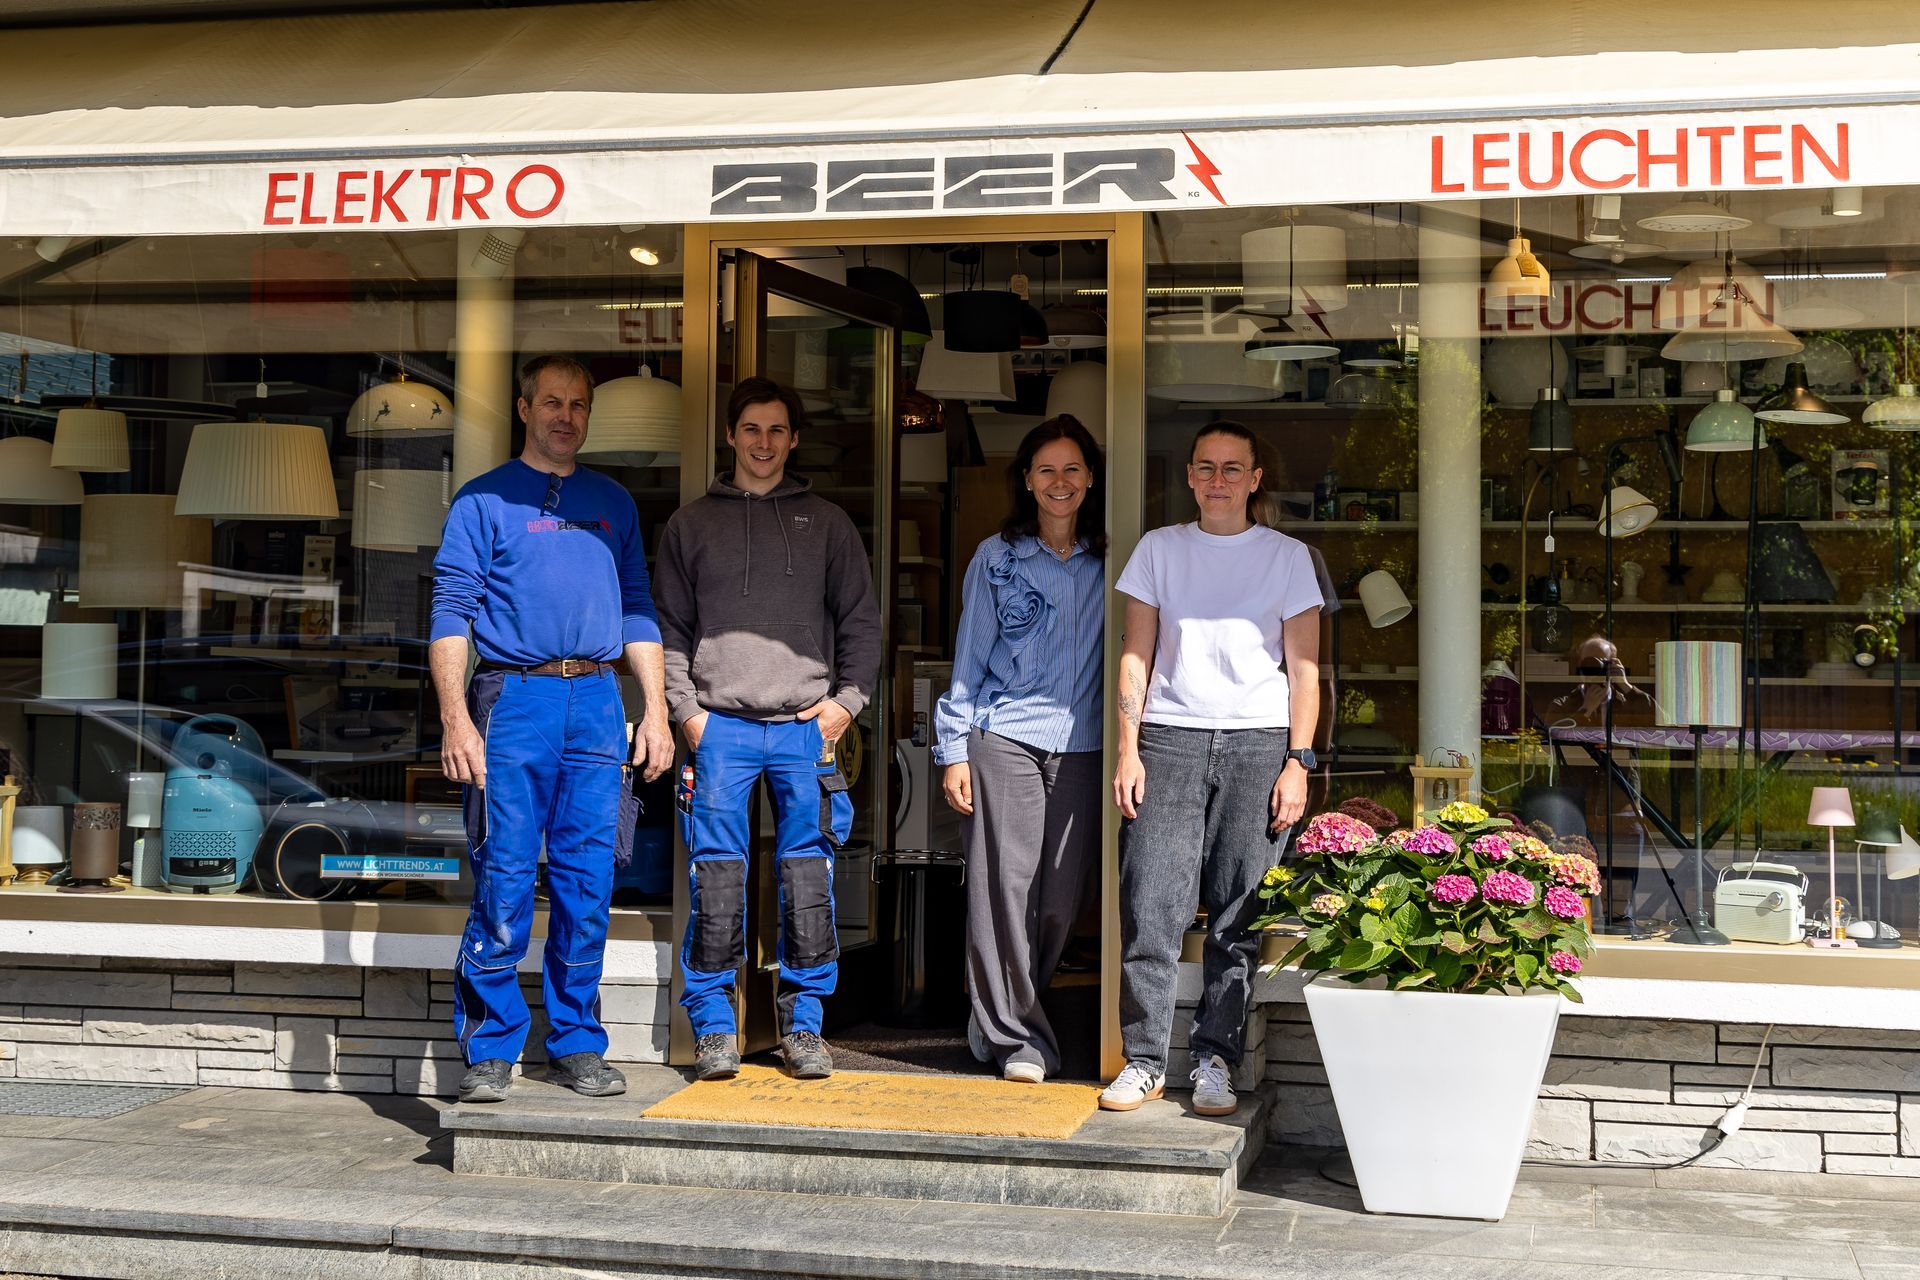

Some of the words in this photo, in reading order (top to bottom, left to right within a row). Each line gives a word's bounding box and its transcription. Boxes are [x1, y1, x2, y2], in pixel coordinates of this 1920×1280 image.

[710, 147, 1178, 215] BEER
[1432, 123, 1850, 193] LEUCHTEN
[264, 164, 565, 225] ELEKTRO
[1478, 281, 1775, 331] LEUCHTEN
[337, 859, 445, 871] WWW.LICHTTRENDS.AT
